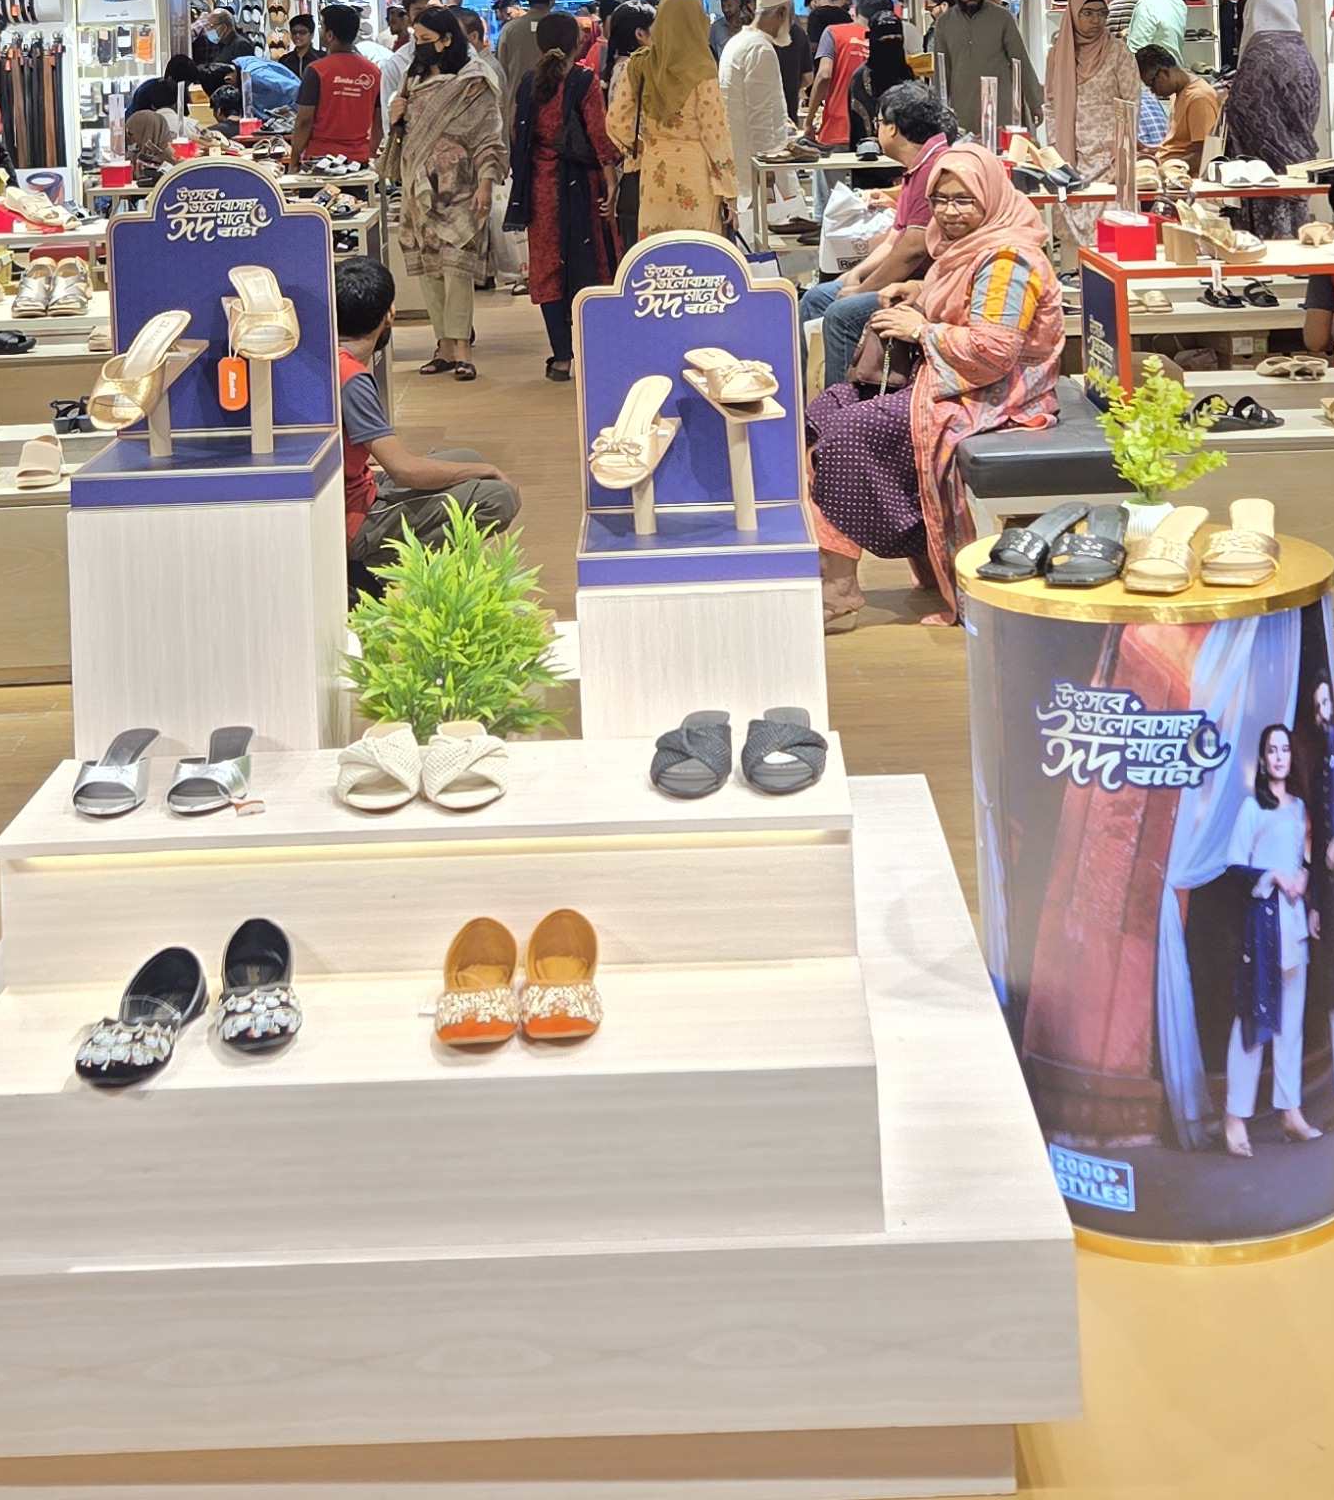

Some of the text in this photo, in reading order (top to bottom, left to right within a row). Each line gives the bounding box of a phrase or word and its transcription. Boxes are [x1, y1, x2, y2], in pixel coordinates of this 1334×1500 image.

[176, 187, 219, 202] উৎসবে
[188, 198, 258, 212] ভালোবাসায়
[164, 202, 250, 241] ঈদ মানে
[217, 223, 258, 237] বাটা
[644, 263, 687, 278] উৎসবে
[656, 275, 726, 289] ভালোবাসায়
[632, 279, 718, 318] ঈদ মানে
[684, 300, 726, 314] বাটা
[1055, 683, 1130, 714] উৎসবে
[1076, 711, 1205, 738] ভালোবাসায়
[1036, 704, 1188, 790] ঈদ মানে
[1126, 761, 1206, 786] বাটা
[1056, 1153, 1120, 1184] 2000+
[1057, 1172, 1128, 1205] STYLES
